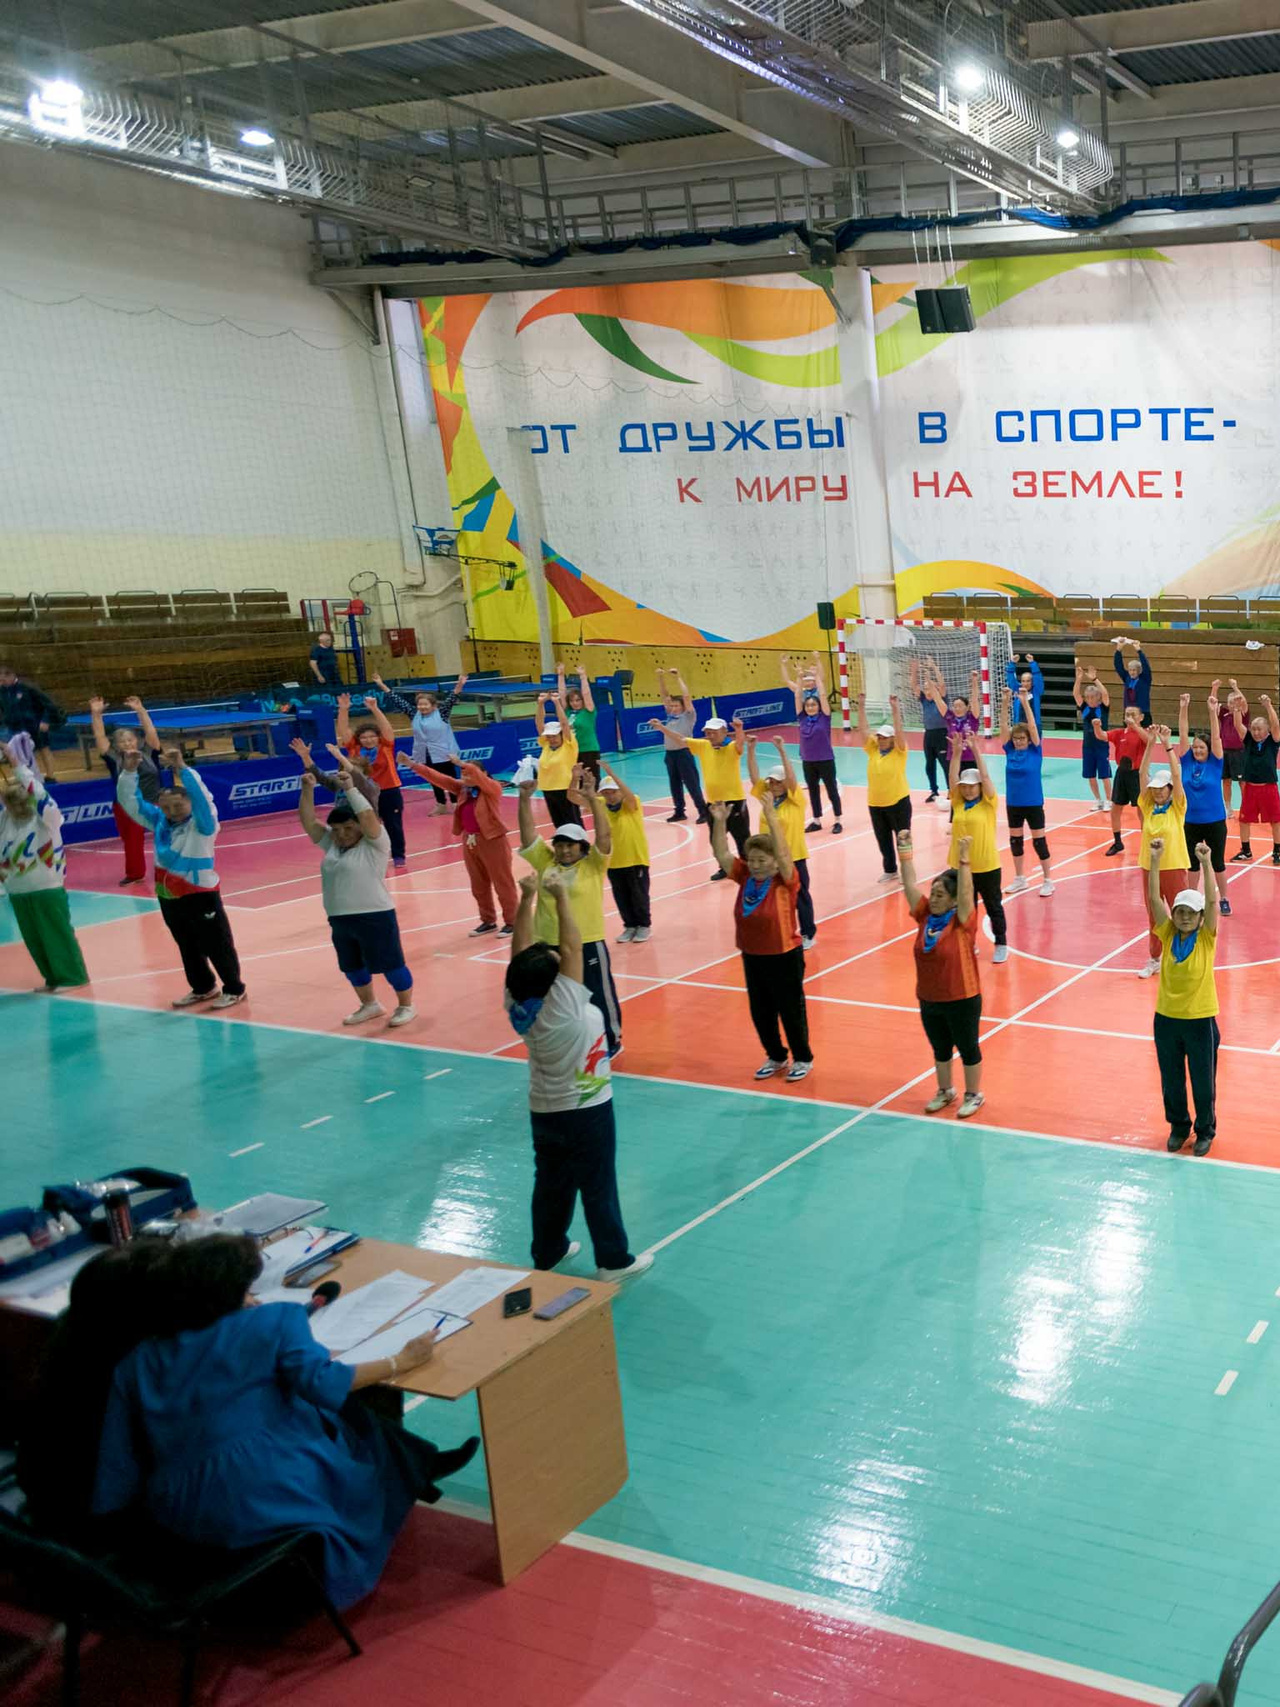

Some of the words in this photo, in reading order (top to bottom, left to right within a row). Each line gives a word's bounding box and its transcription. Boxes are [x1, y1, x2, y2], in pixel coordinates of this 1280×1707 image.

[618, 416, 845, 453] ДРУЖБЫ
[918, 411, 948, 444] В
[995, 408, 1236, 442] СПОРТЕ-
[677, 477, 703, 503] К
[735, 474, 848, 502] МИРУ
[912, 471, 973, 498] НА
[1012, 470, 1183, 498] ЗЕМЛЕ!
[460, 748, 491, 760] LINE
[234, 779, 297, 797] START
[82, 804, 113, 819] LIN
